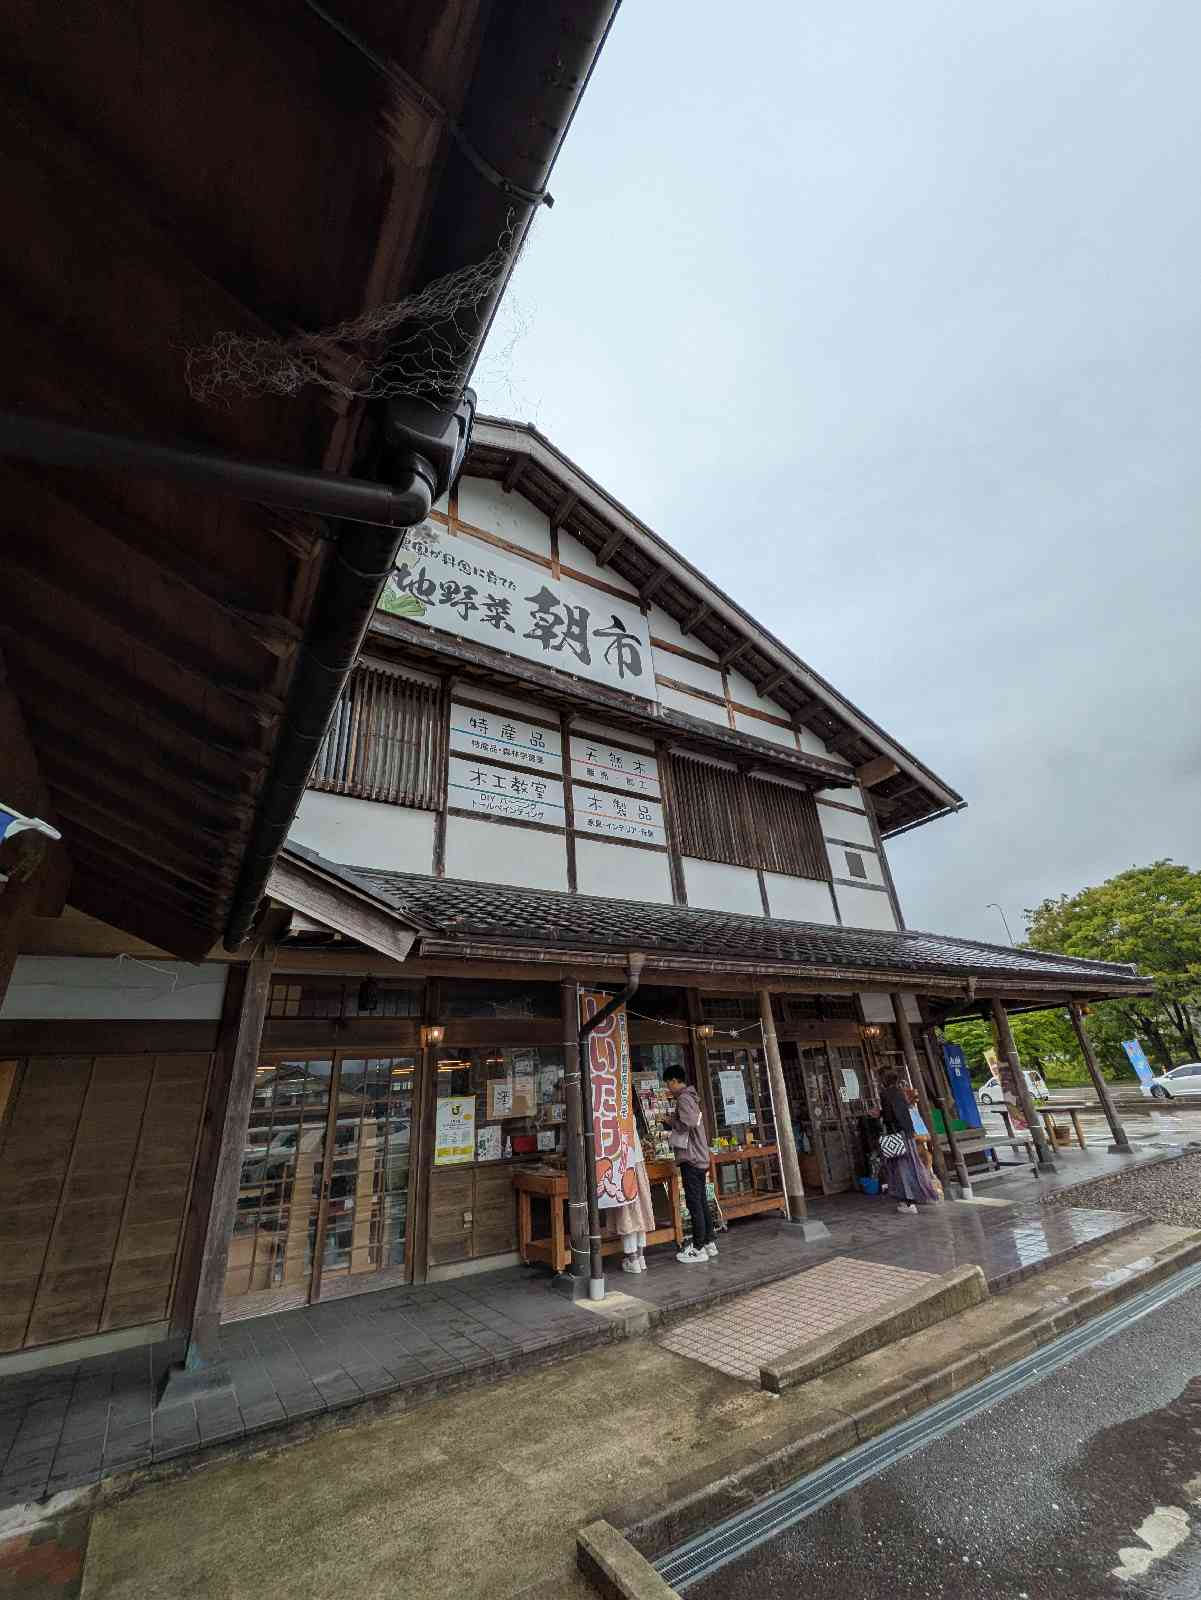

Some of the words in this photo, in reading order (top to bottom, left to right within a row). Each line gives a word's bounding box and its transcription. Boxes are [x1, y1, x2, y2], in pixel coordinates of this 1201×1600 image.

[469, 716, 546, 748] 特産品
[585, 745, 649, 775] 天然木
[469, 767, 547, 799] 木工教室
[587, 793, 653, 822] 木製品
